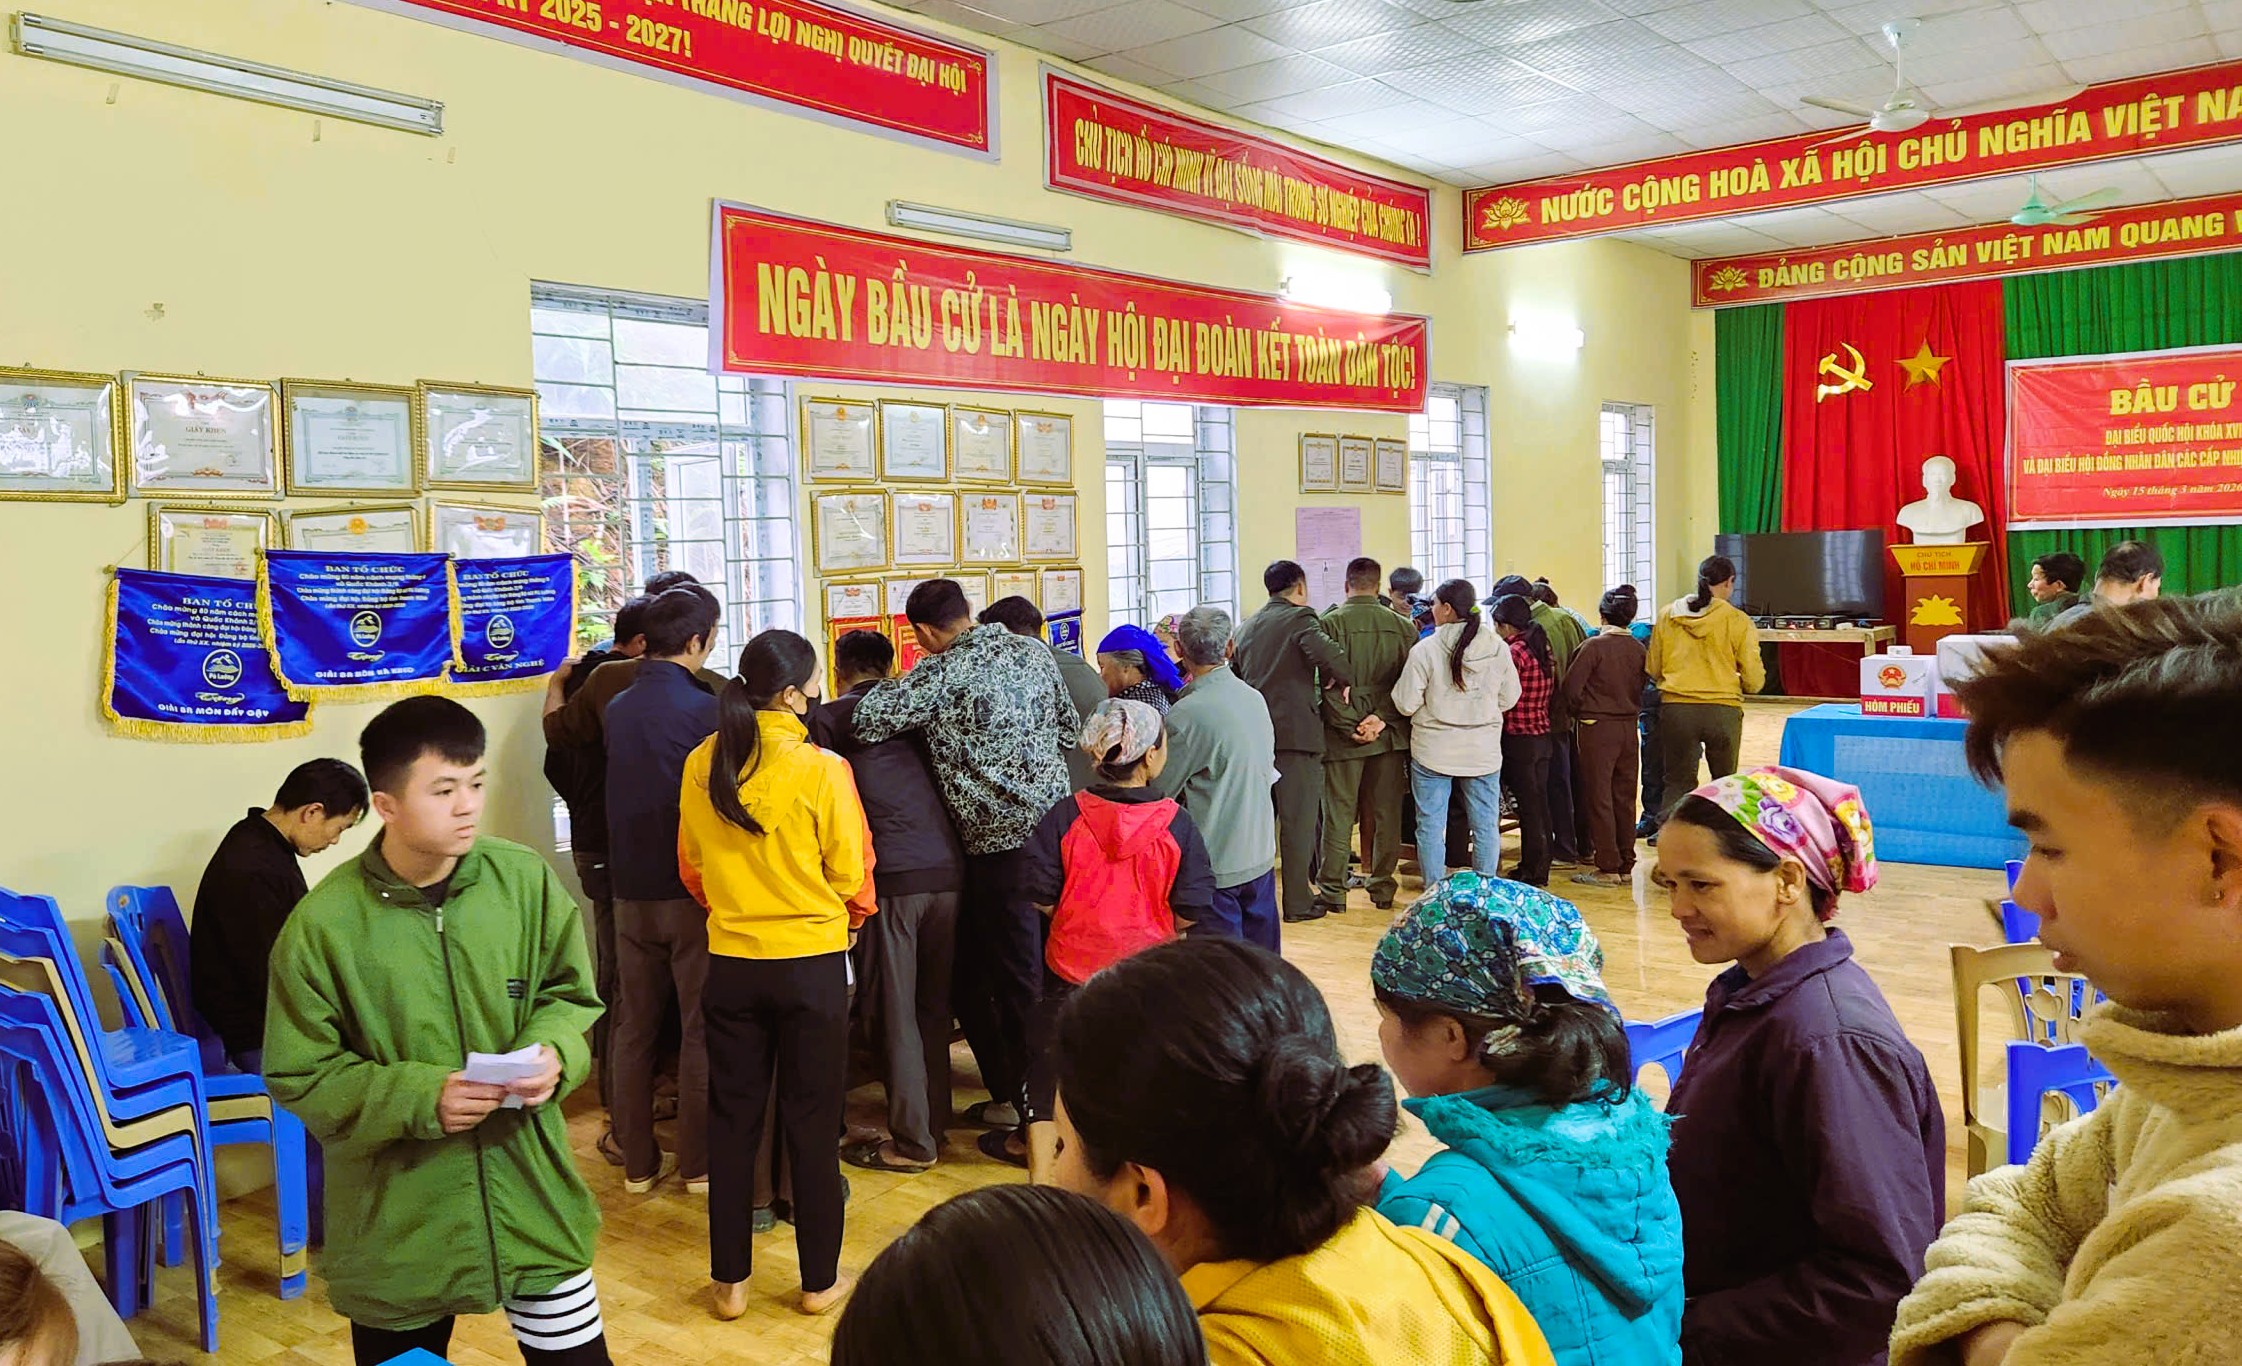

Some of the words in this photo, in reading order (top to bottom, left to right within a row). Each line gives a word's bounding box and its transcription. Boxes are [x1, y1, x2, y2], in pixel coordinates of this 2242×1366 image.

[540, 0, 602, 32] 2025
[625, 13, 692, 58] 2027!
[757, 7, 791, 45] LỢI
[796, 19, 844, 62] NGHỊ
[848, 36, 903, 74] QUYẾT
[906, 52, 936, 88] ĐẠI
[938, 61, 967, 96] HỘI
[1074, 104, 1103, 170] CHỦ
[1540, 181, 1614, 225] NƯỚC
[1623, 174, 1700, 214] CỘNG
[1709, 157, 1771, 200] HOÀ
[1779, 148, 1823, 189] XÃ
[1833, 140, 1887, 183] HỘI
[1898, 118, 1967, 170] CHỦ
[1978, 107, 2092, 158] NGHĨA
[2102, 92, 2186, 140] VIỆT
[1757, 258, 1826, 289] ĐẢNG
[1833, 252, 1903, 283] CỘNG
[1912, 238, 1968, 271] SẢN
[1975, 233, 2034, 265] VIỆT
[2043, 226, 2110, 256] NAM
[2119, 212, 2225, 248] QUANG
[757, 256, 856, 342] NGÀY
[866, 259, 932, 350] BẦU
[941, 270, 984, 354] CỬ
[988, 284, 1025, 358] LÀ
[1030, 293, 1100, 365] NGÀY
[1107, 301, 1147, 382] HỘI
[1153, 316, 1190, 385] ĐẠI
[1196, 315, 1252, 378] ĐOÀN
[1257, 316, 1291, 381] KẾT
[1294, 326, 1342, 384] TOÀN
[1345, 331, 1379, 388] DÂN
[1381, 336, 1416, 399] TỘC!
[2109, 377, 2179, 415] BẦU
[2187, 374, 2237, 411] CỬ
[2148, 421, 2175, 445] QUỐC
[2176, 422, 2194, 445] HỘI
[2124, 450, 2152, 471] NHÂN
[2132, 486, 2146, 496] 15
[2179, 485, 2188, 494] 3
[182, 597, 210, 606] BAN
[235, 601, 257, 609] CH
[1889, 699, 1920, 714] PHIẾU
